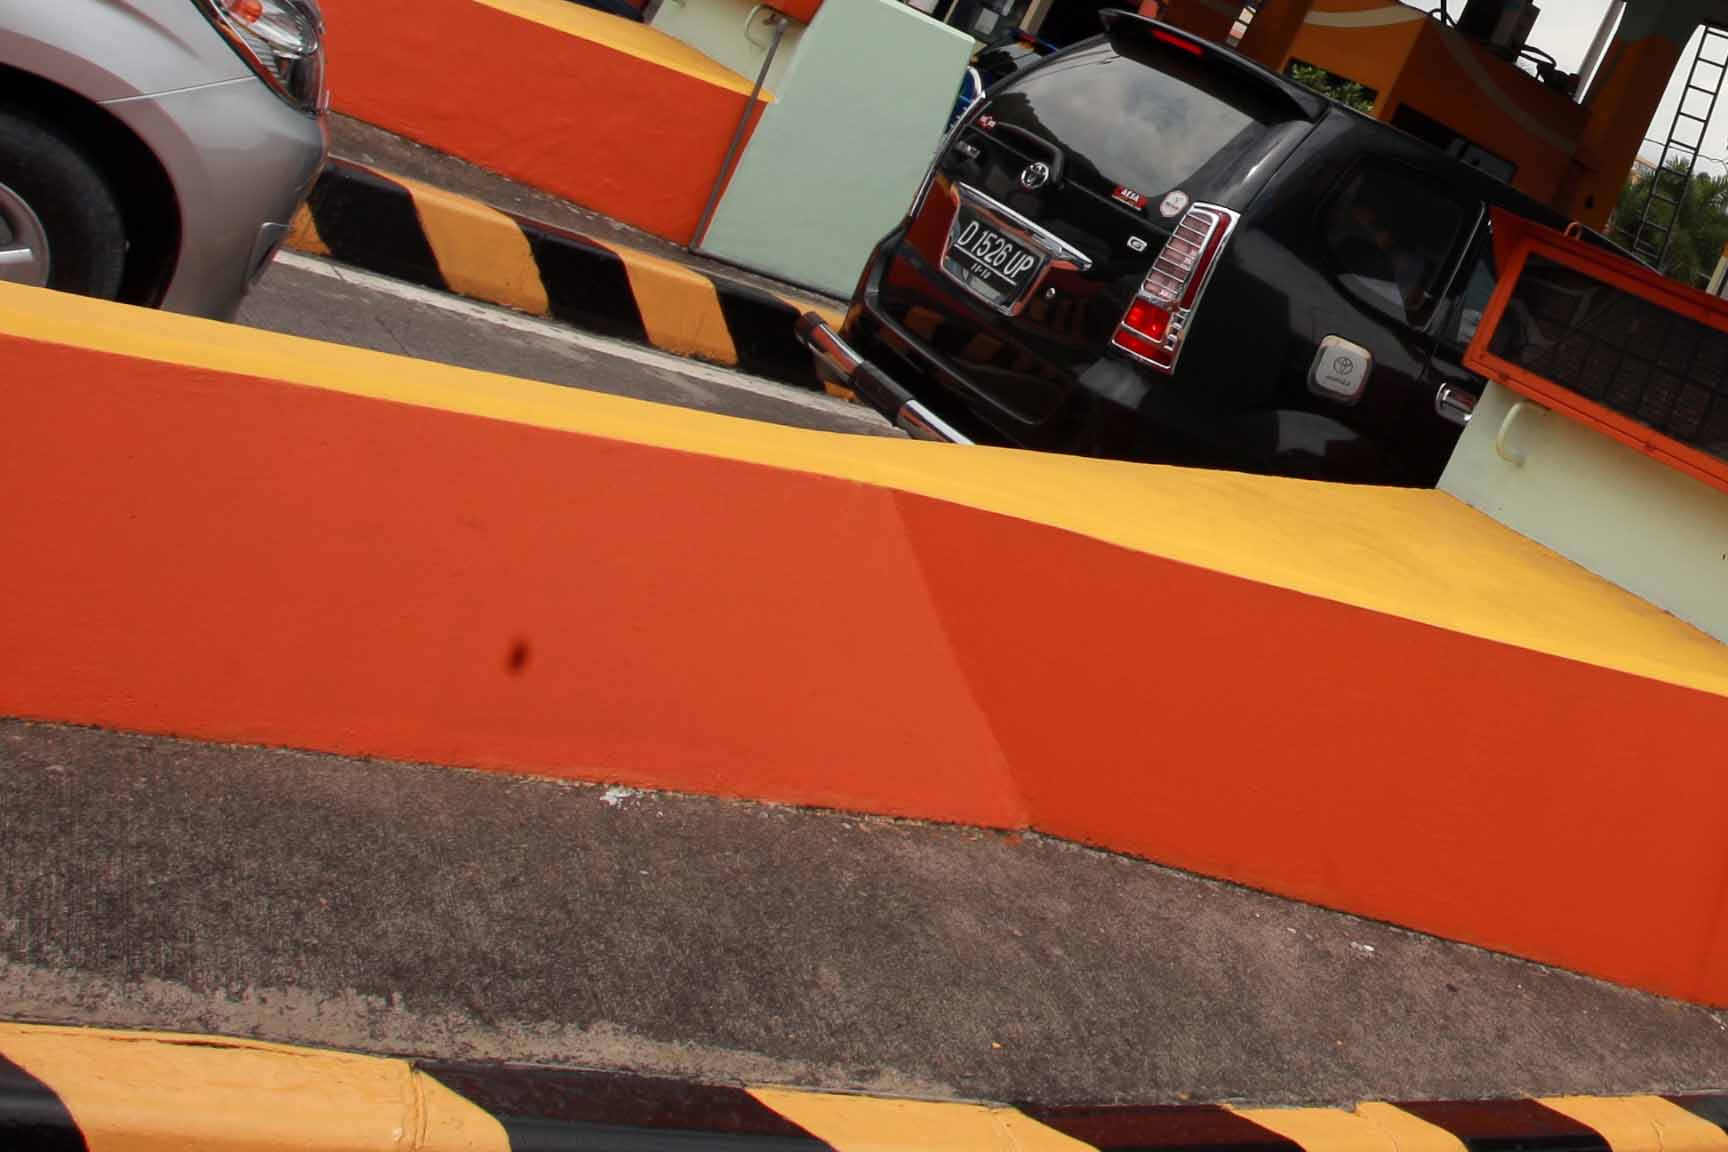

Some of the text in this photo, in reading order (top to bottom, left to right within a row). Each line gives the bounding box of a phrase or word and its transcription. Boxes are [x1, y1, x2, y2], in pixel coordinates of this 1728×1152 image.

[957, 220, 1034, 278] D 1526 UP
